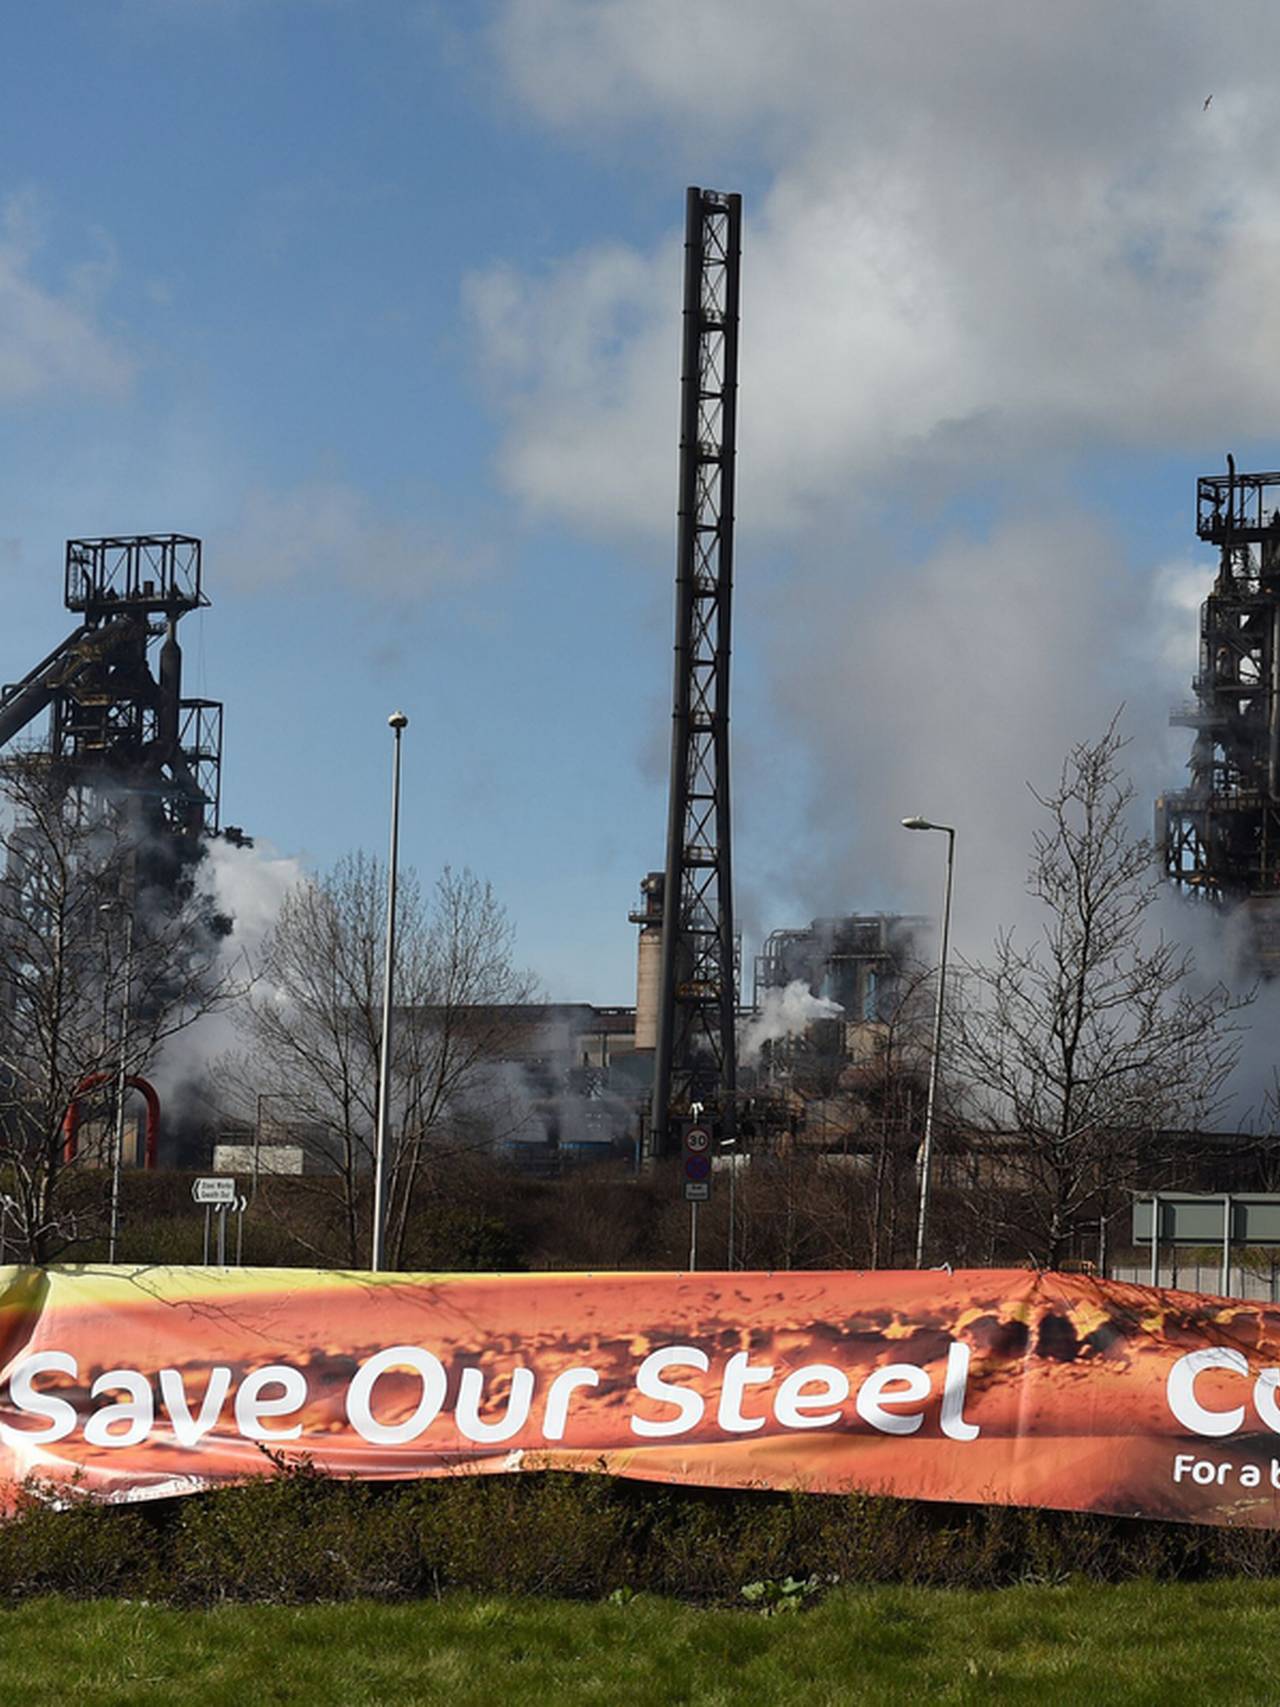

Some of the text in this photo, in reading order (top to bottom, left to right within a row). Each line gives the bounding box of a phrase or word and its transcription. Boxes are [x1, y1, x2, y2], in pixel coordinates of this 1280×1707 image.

[691, 1135, 706, 1147] 30
[0, 1341, 980, 1448] Save Our Steel
[1173, 1454, 1234, 1486] For
[1239, 1464, 1261, 1488] a
